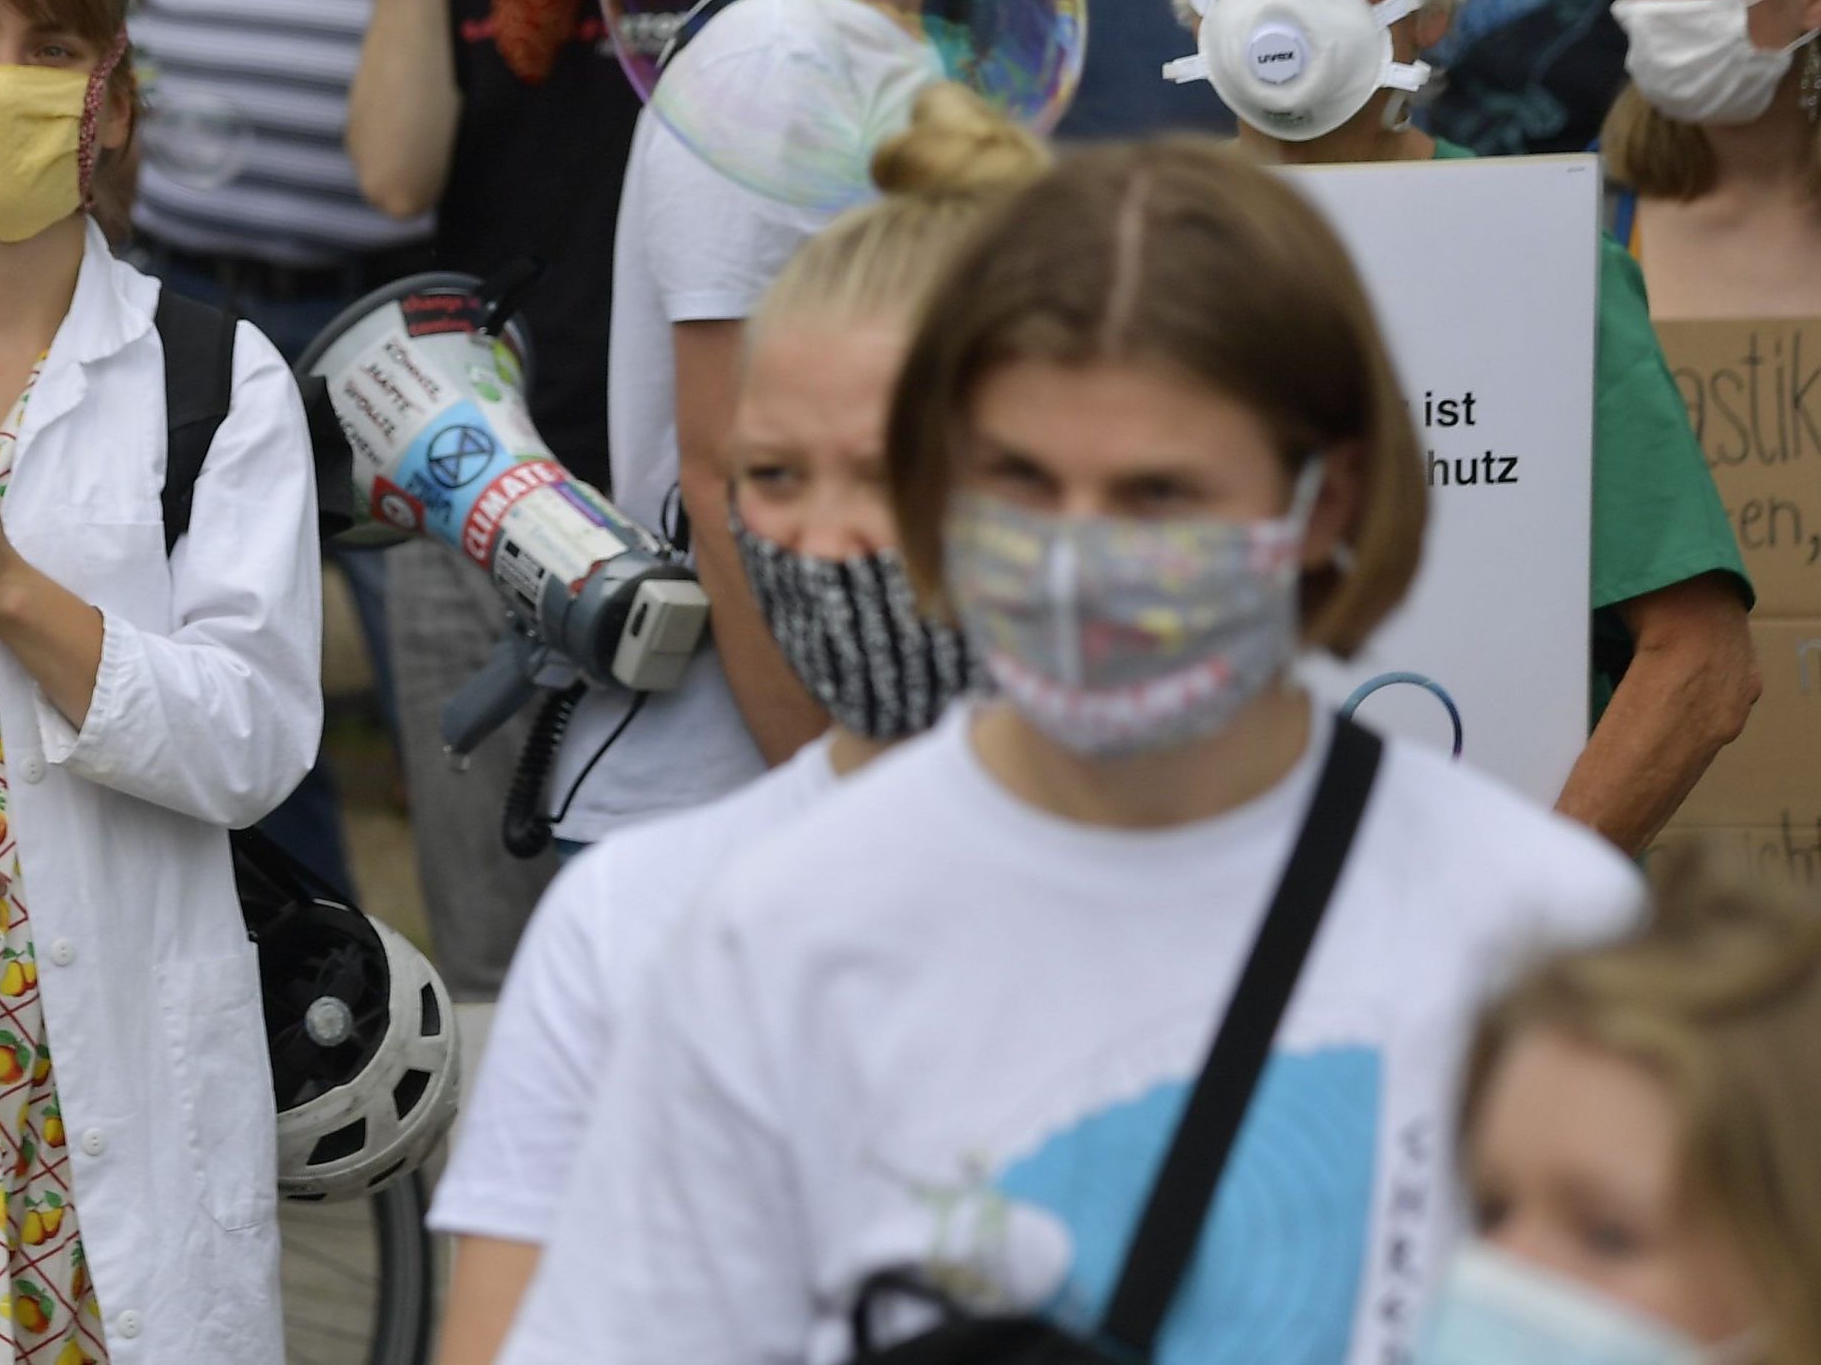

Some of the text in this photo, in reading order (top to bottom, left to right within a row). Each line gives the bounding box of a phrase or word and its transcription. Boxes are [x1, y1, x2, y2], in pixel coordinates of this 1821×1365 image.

[1257, 50, 1295, 64] uvex
[1424, 390, 1476, 427] ist
[1427, 449, 1519, 486] hutz
[466, 462, 556, 560] CLIMATE
